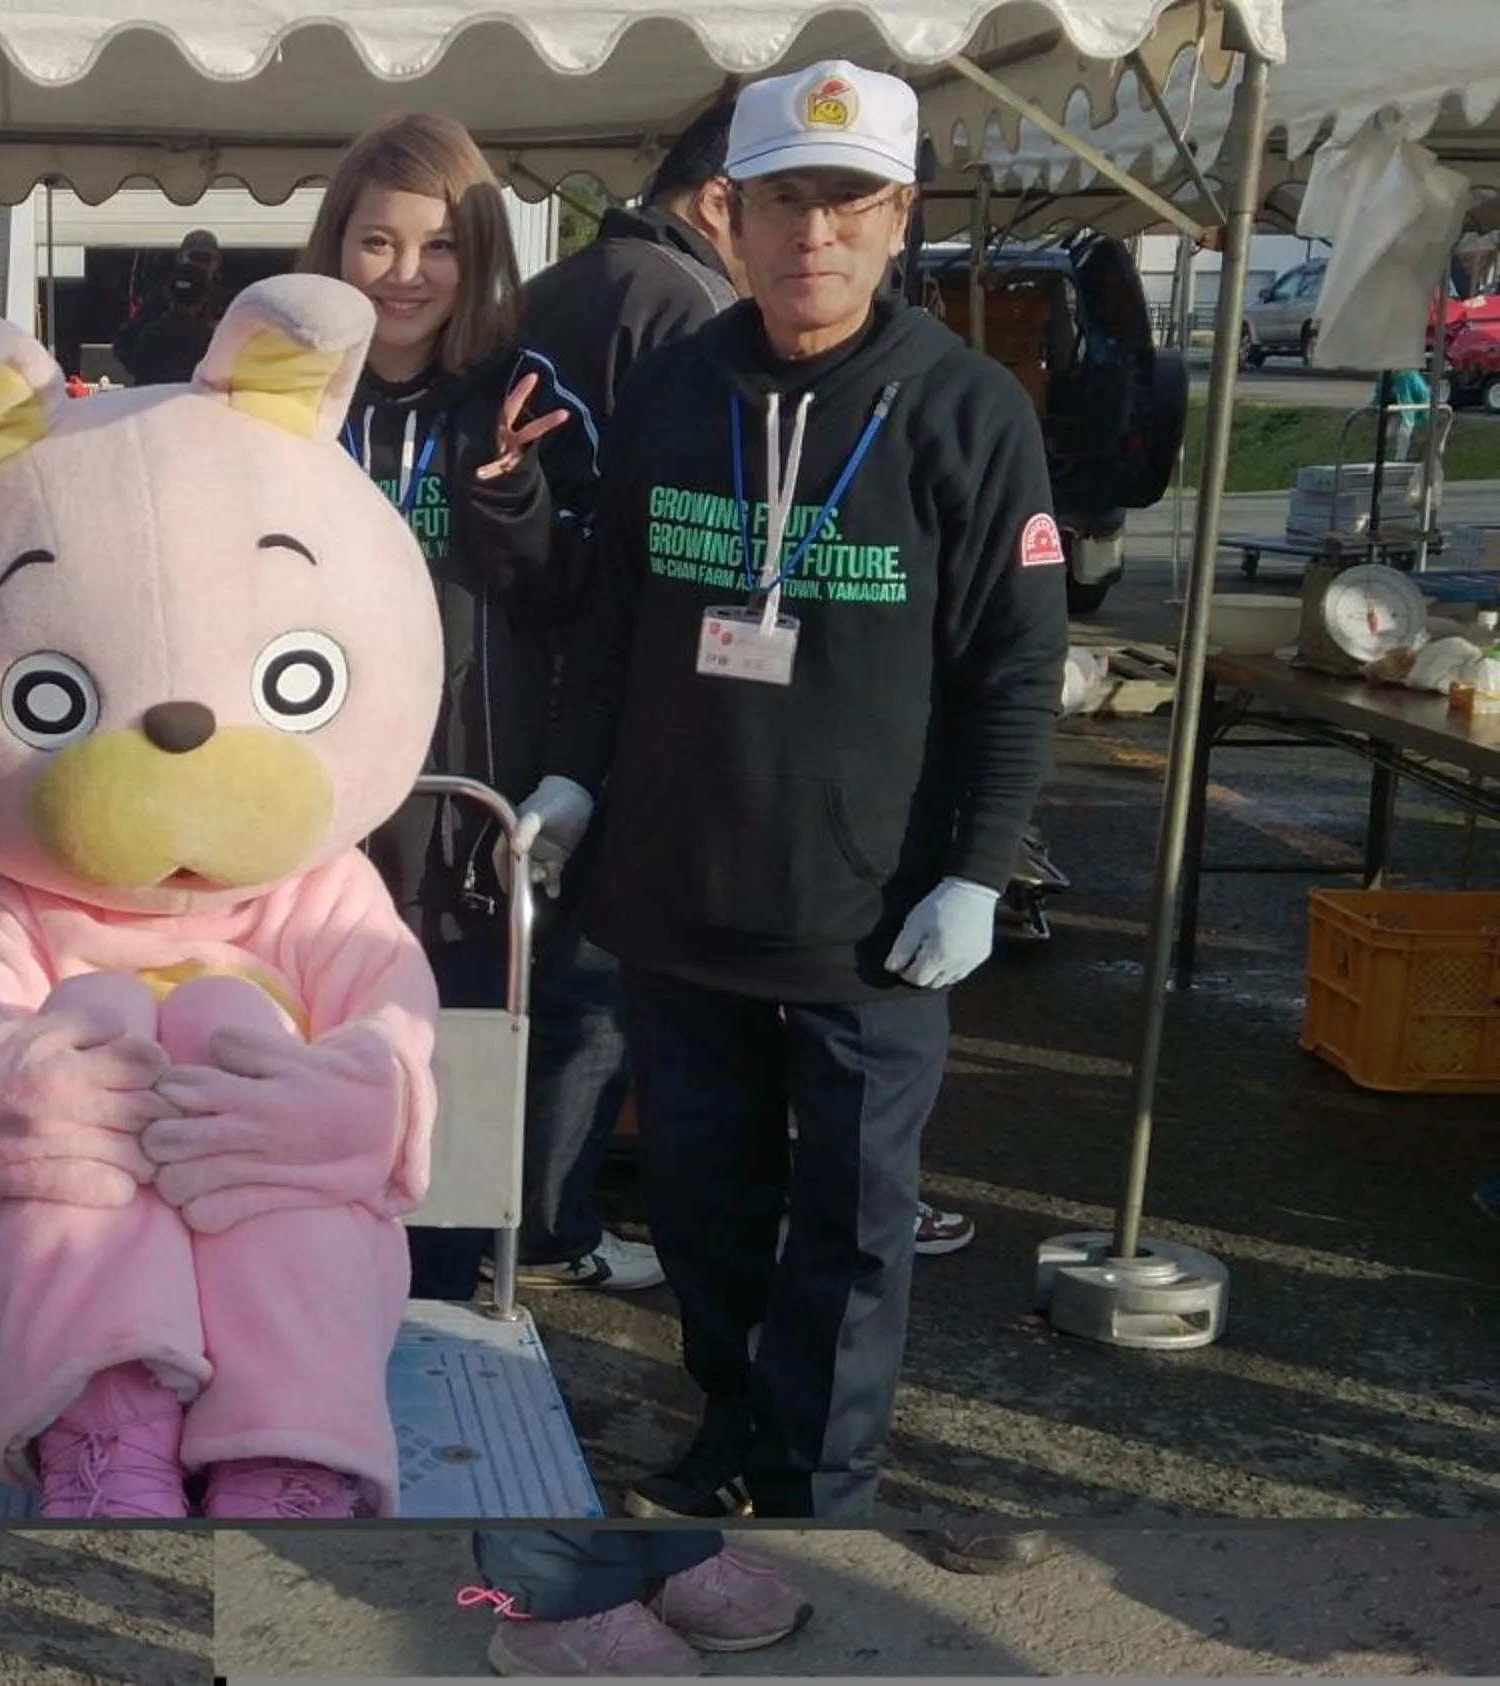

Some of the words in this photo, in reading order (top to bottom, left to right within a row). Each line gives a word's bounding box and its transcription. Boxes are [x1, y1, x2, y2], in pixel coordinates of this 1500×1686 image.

[649, 485, 749, 531] GROWING
[753, 501, 843, 540] FUITS.
[649, 521, 745, 567] GROWING
[802, 543, 907, 580] FUTURE.
[827, 581, 907, 602] YAMAGATA
